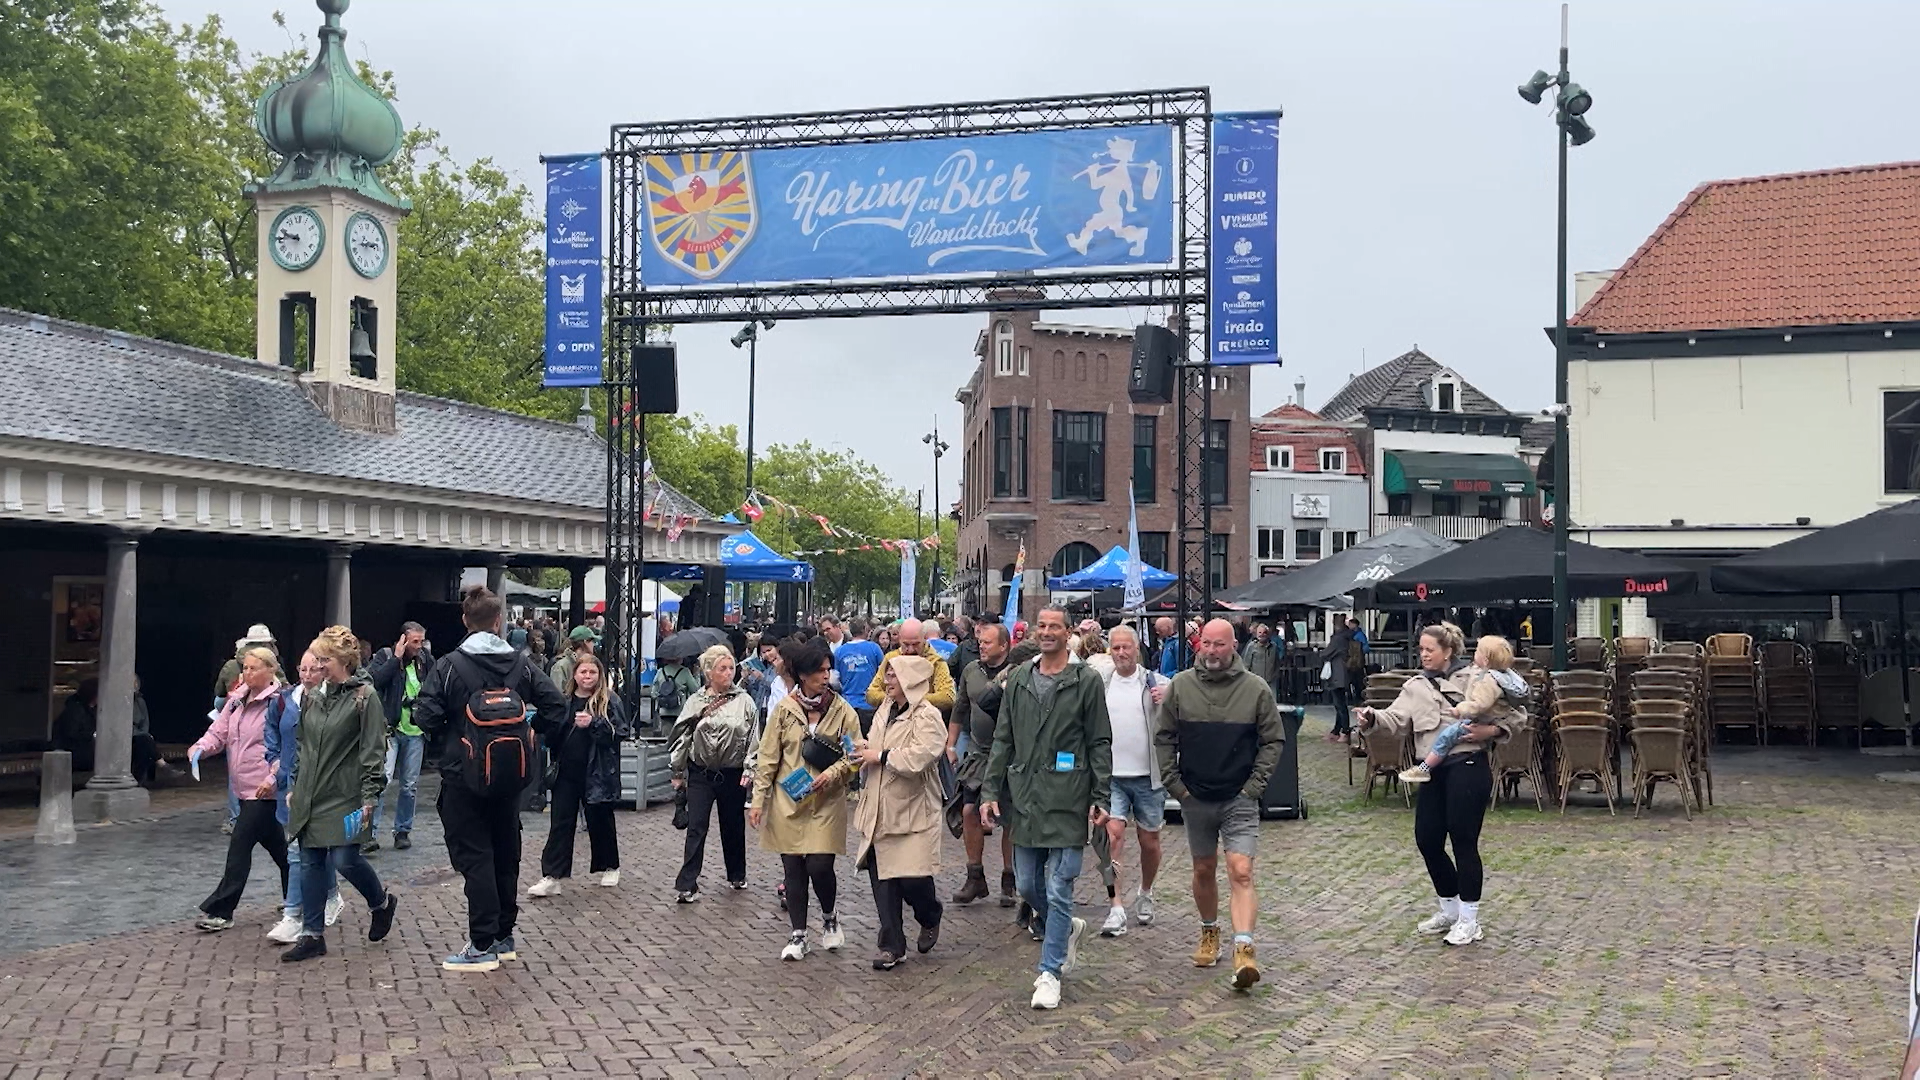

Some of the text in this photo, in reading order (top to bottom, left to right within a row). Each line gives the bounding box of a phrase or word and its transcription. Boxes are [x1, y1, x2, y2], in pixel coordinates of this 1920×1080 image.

[785, 149, 1031, 242] Haring en Bier
[1222, 189, 1267, 203] JUMBO
[907, 204, 1046, 252] Wandeltocht
[1224, 318, 1264, 334] irado
[1624, 577, 1669, 593] Duvel
